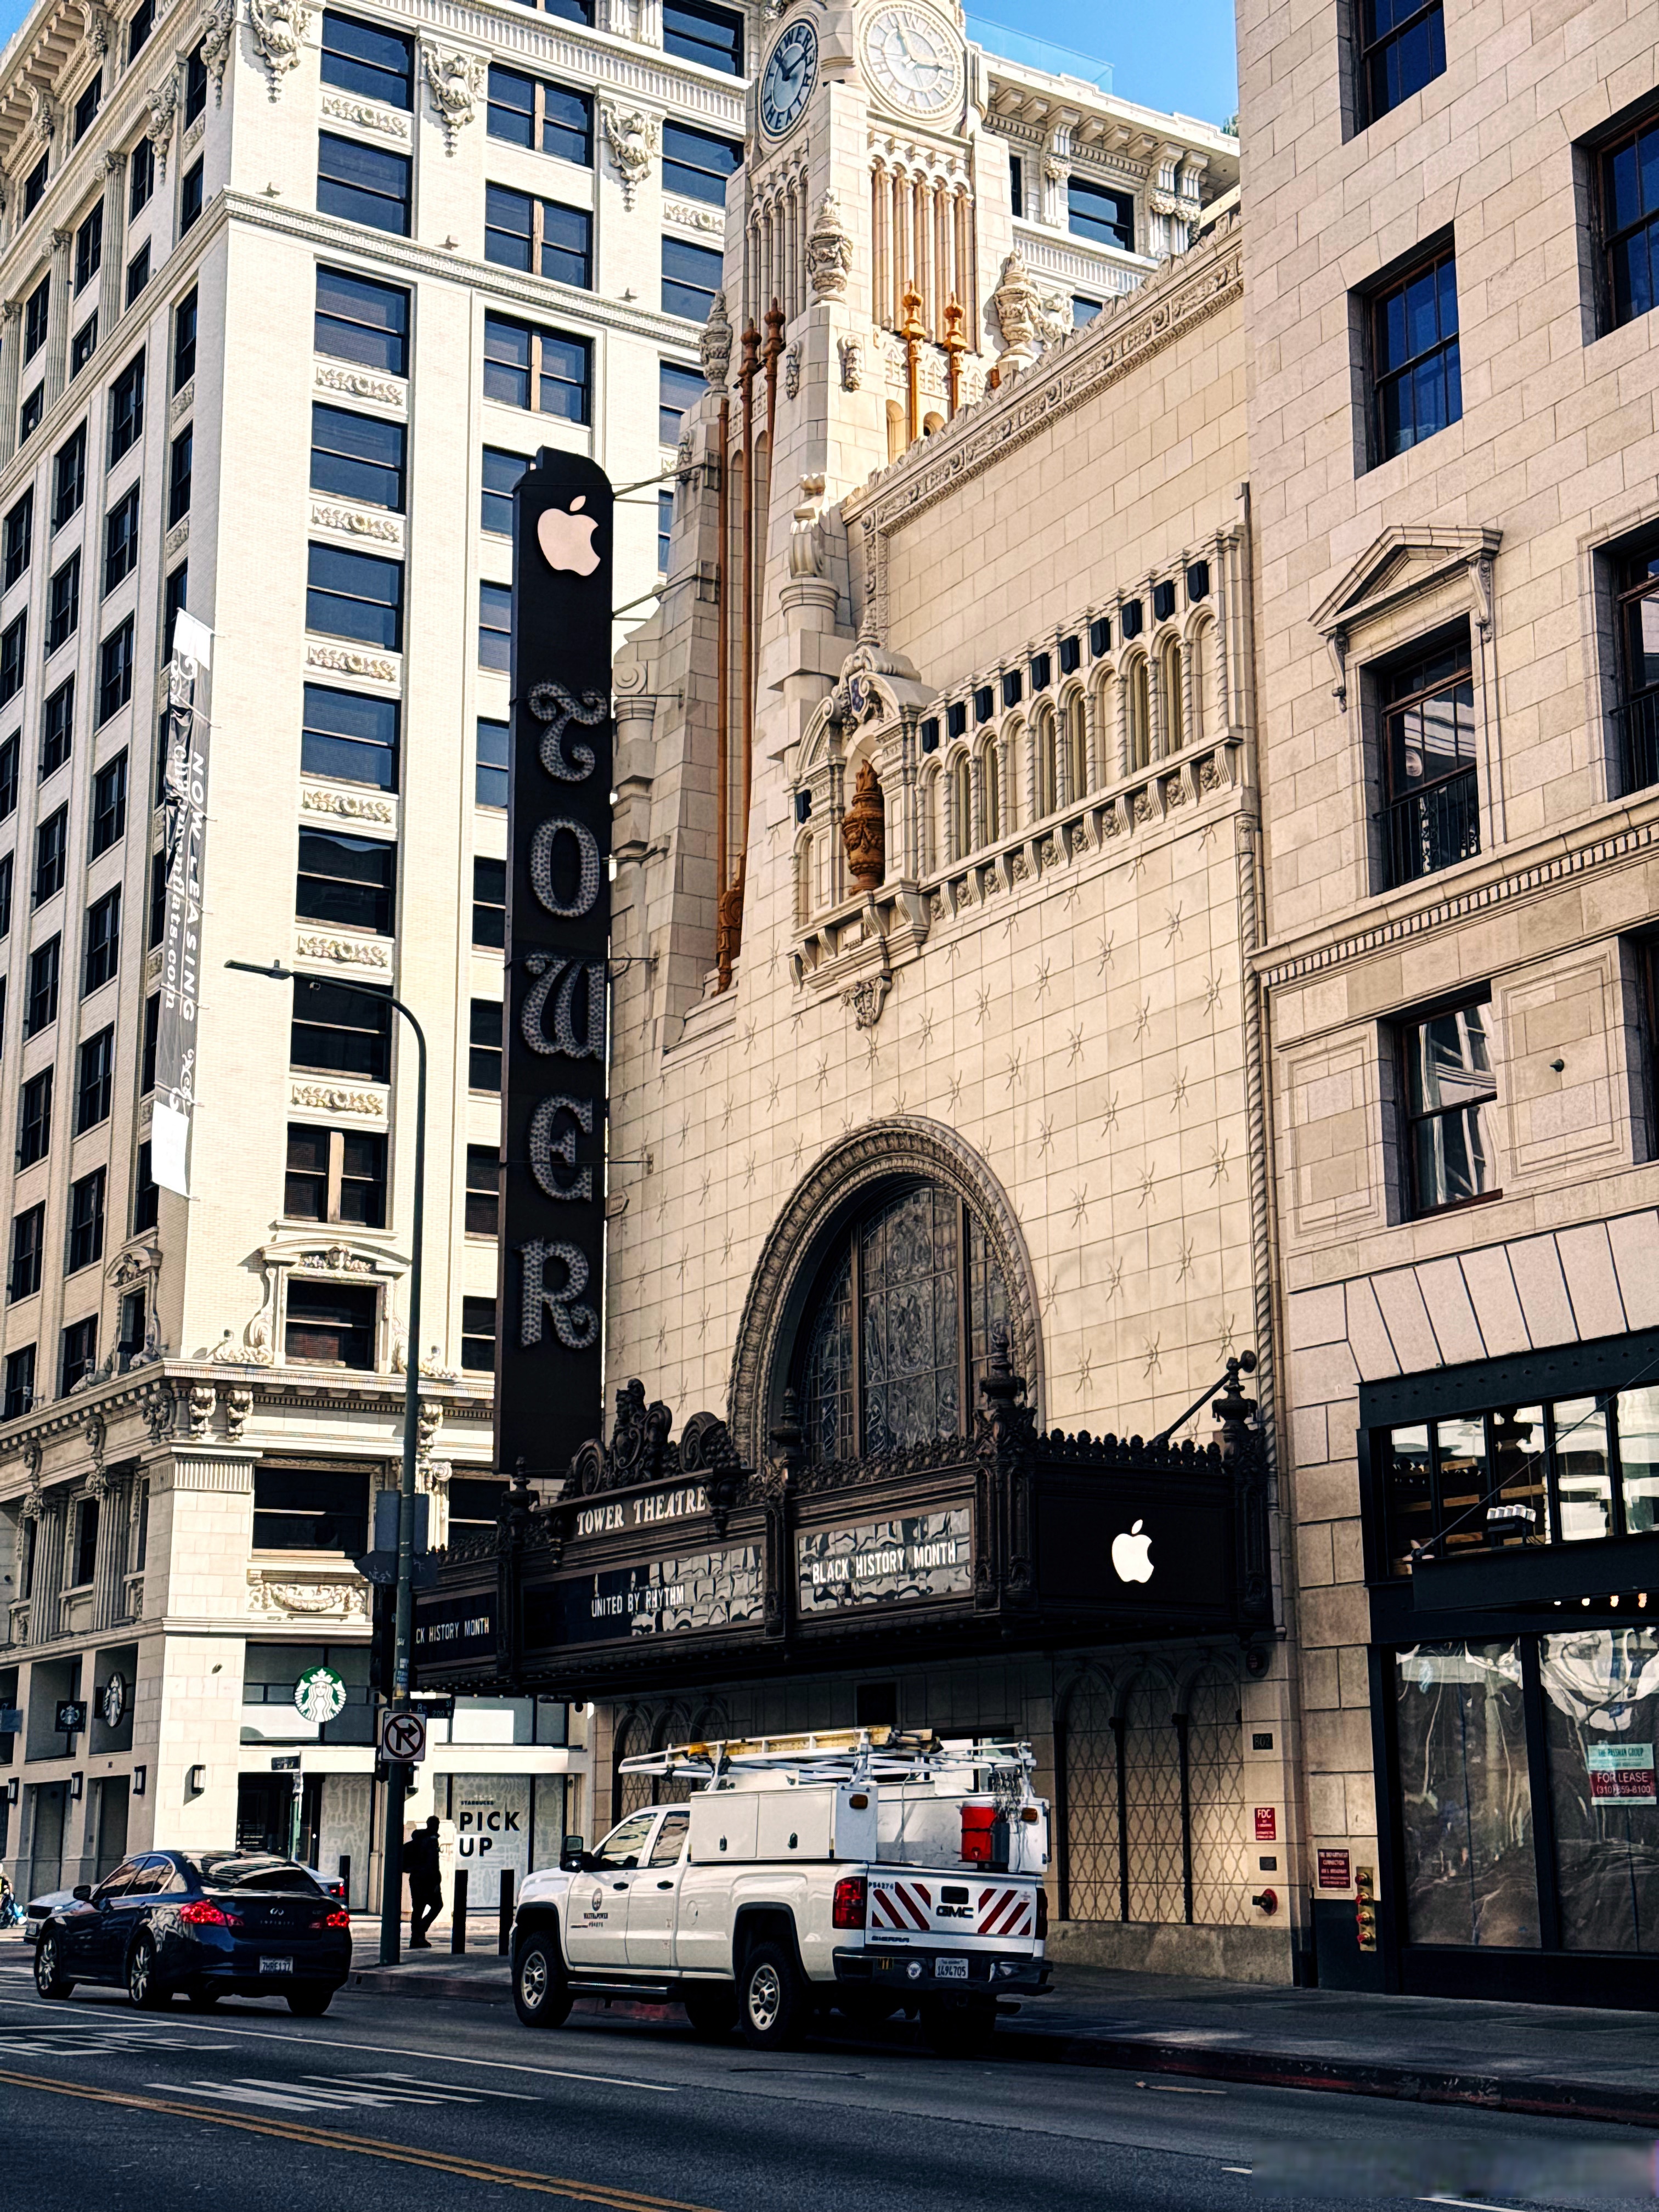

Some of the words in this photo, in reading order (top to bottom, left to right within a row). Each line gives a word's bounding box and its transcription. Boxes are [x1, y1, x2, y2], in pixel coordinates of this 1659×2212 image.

[191, 751, 204, 840] NOW
[183, 855, 200, 1022] LEASING
[512, 678, 607, 1348] TOWER
[577, 1504, 624, 1536] TOWER
[634, 1486, 706, 1524] THEATRE
[812, 1558, 849, 1584] BLACK
[856, 1547, 905, 1578] HISTORY
[913, 1541, 956, 1568] MONTH
[591, 1595, 623, 1617] UNITED
[628, 1592, 640, 1612] BY
[646, 1584, 684, 1610] RHYTHM
[429, 1622, 460, 1642] HISTORY
[464, 1616, 489, 1637] MONTH
[1597, 1773, 1617, 1783] FOR
[1618, 1772, 1648, 1782] LEASE
[460, 1811, 520, 1831] PICK
[1257, 1809, 1272, 1819] FDC
[459, 1837, 493, 1857] UP
[936, 1905, 974, 1918] GMC
[144, 2073, 543, 2111] WAIT
